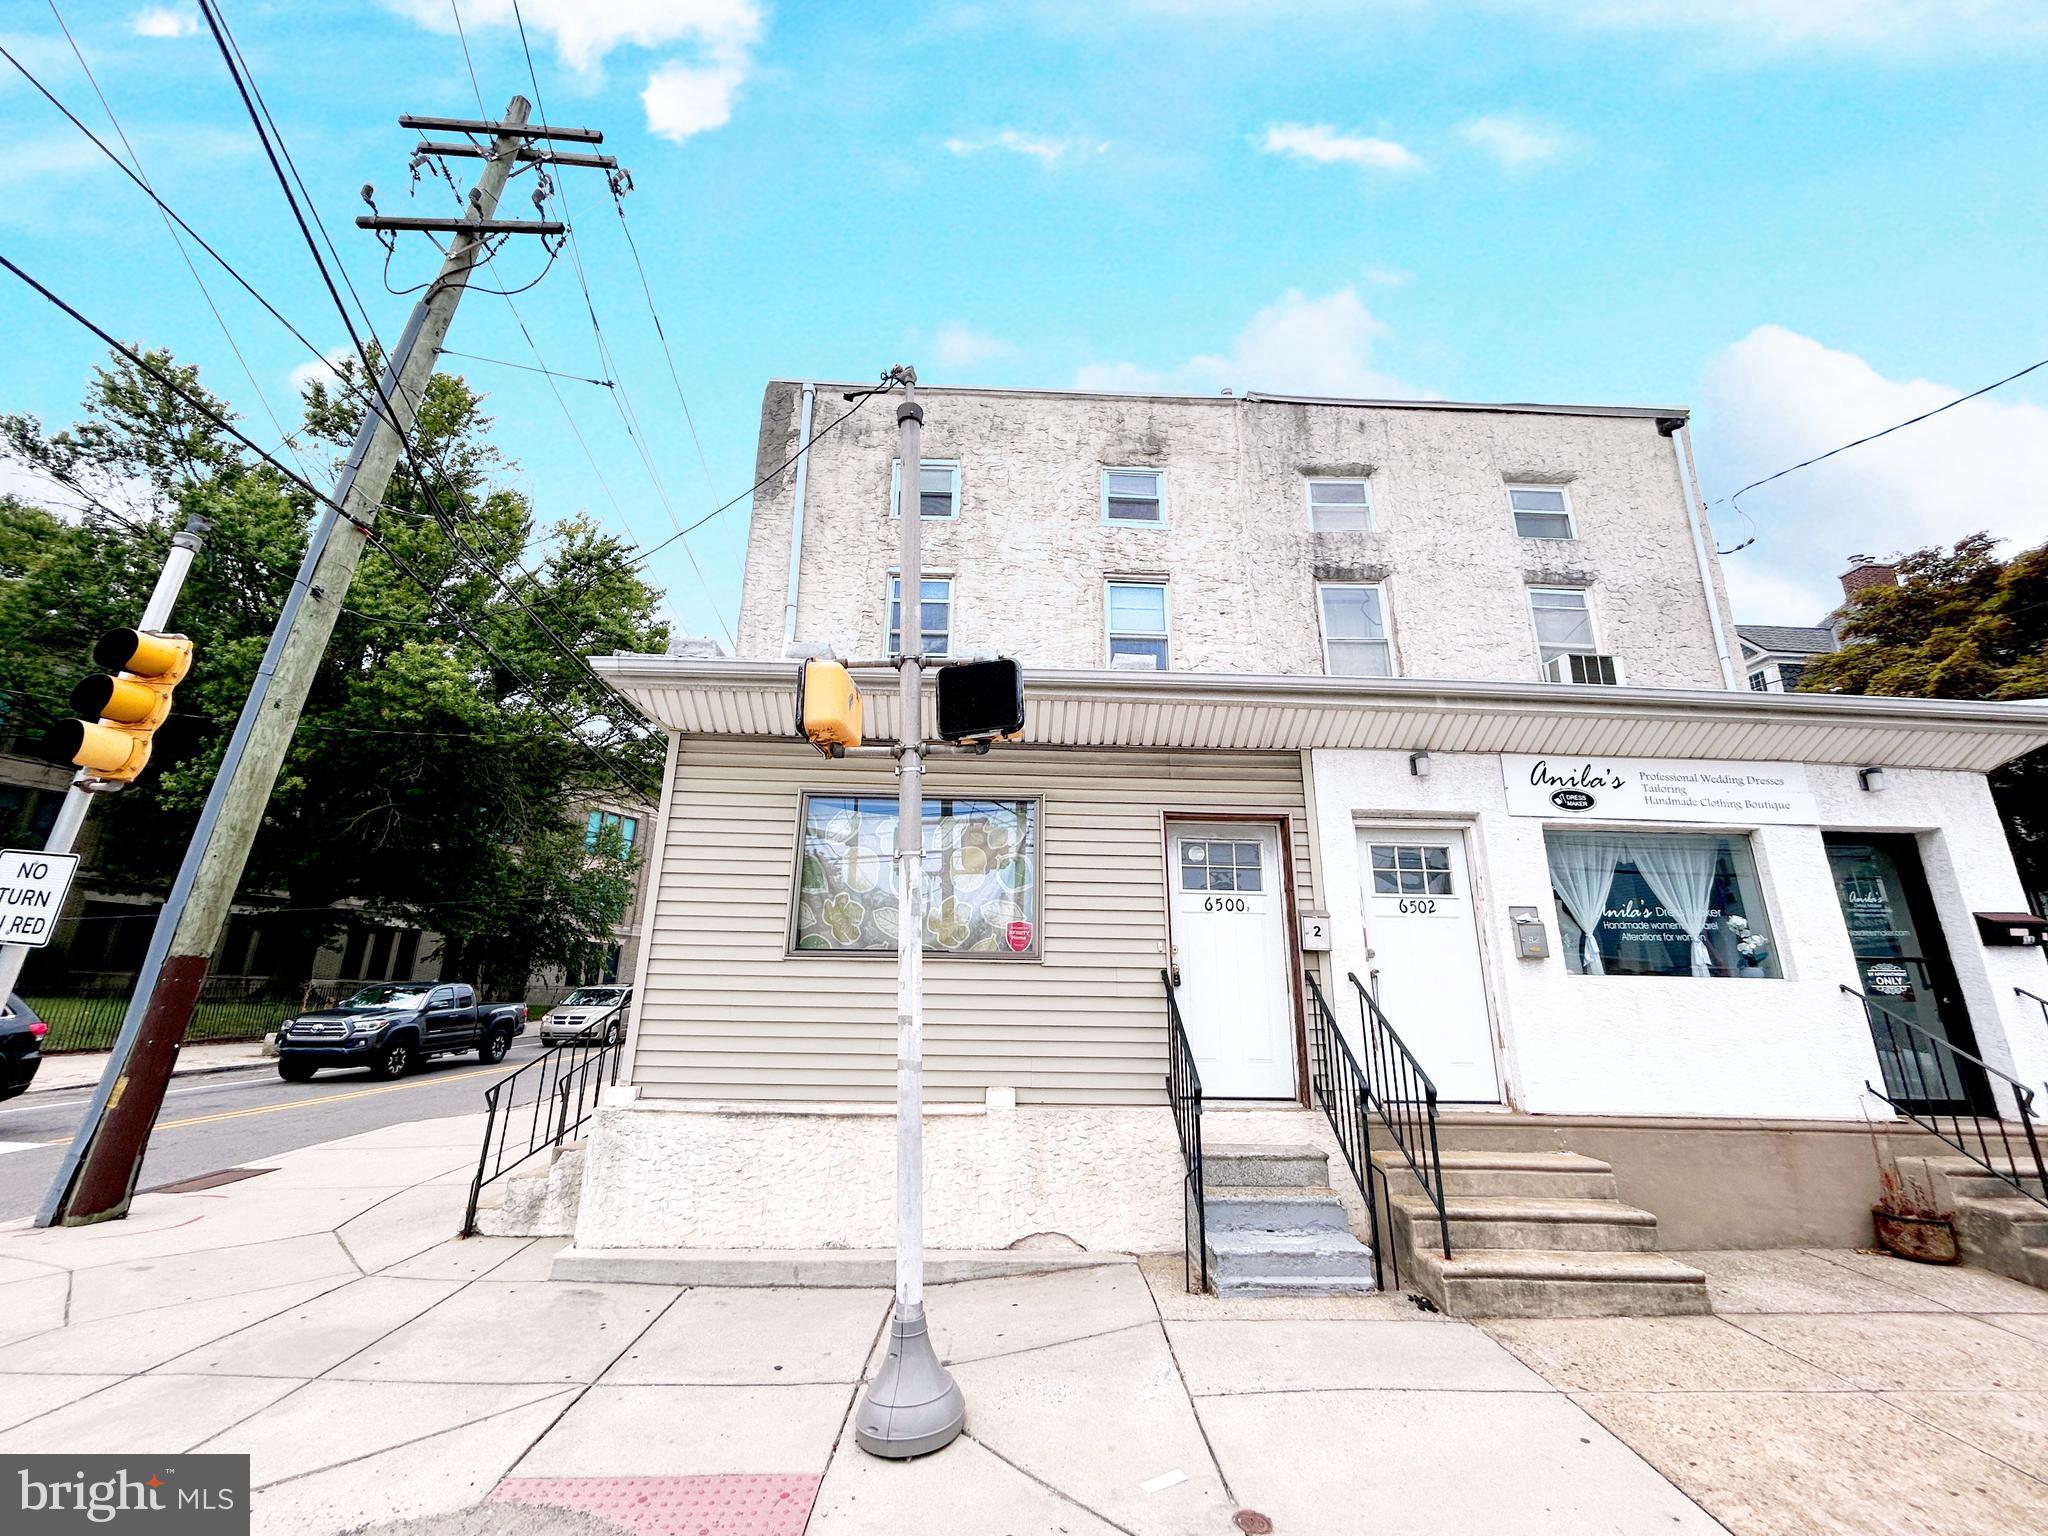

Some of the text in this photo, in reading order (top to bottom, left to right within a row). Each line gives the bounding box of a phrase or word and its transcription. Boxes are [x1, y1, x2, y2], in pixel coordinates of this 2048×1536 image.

[1530, 760, 1626, 789] Anila's
[1639, 772, 1785, 787] Professional Wedding Dresses
[1641, 784, 1688, 795] Tailoring
[1644, 796, 1791, 812] Handmade Clothing Boutique
[17, 862, 49, 880] NO
[0, 887, 52, 907] TURN
[1204, 896, 1245, 912] 6500
[1399, 898, 1437, 914] 6502
[10, 916, 46, 935] RED
[1313, 926, 1322, 937] 2
[1603, 921, 1650, 930] Handmade
[1621, 932, 1662, 941] Alterations
[1663, 933, 1675, 941] for
[1876, 977, 1903, 985] ONLY
